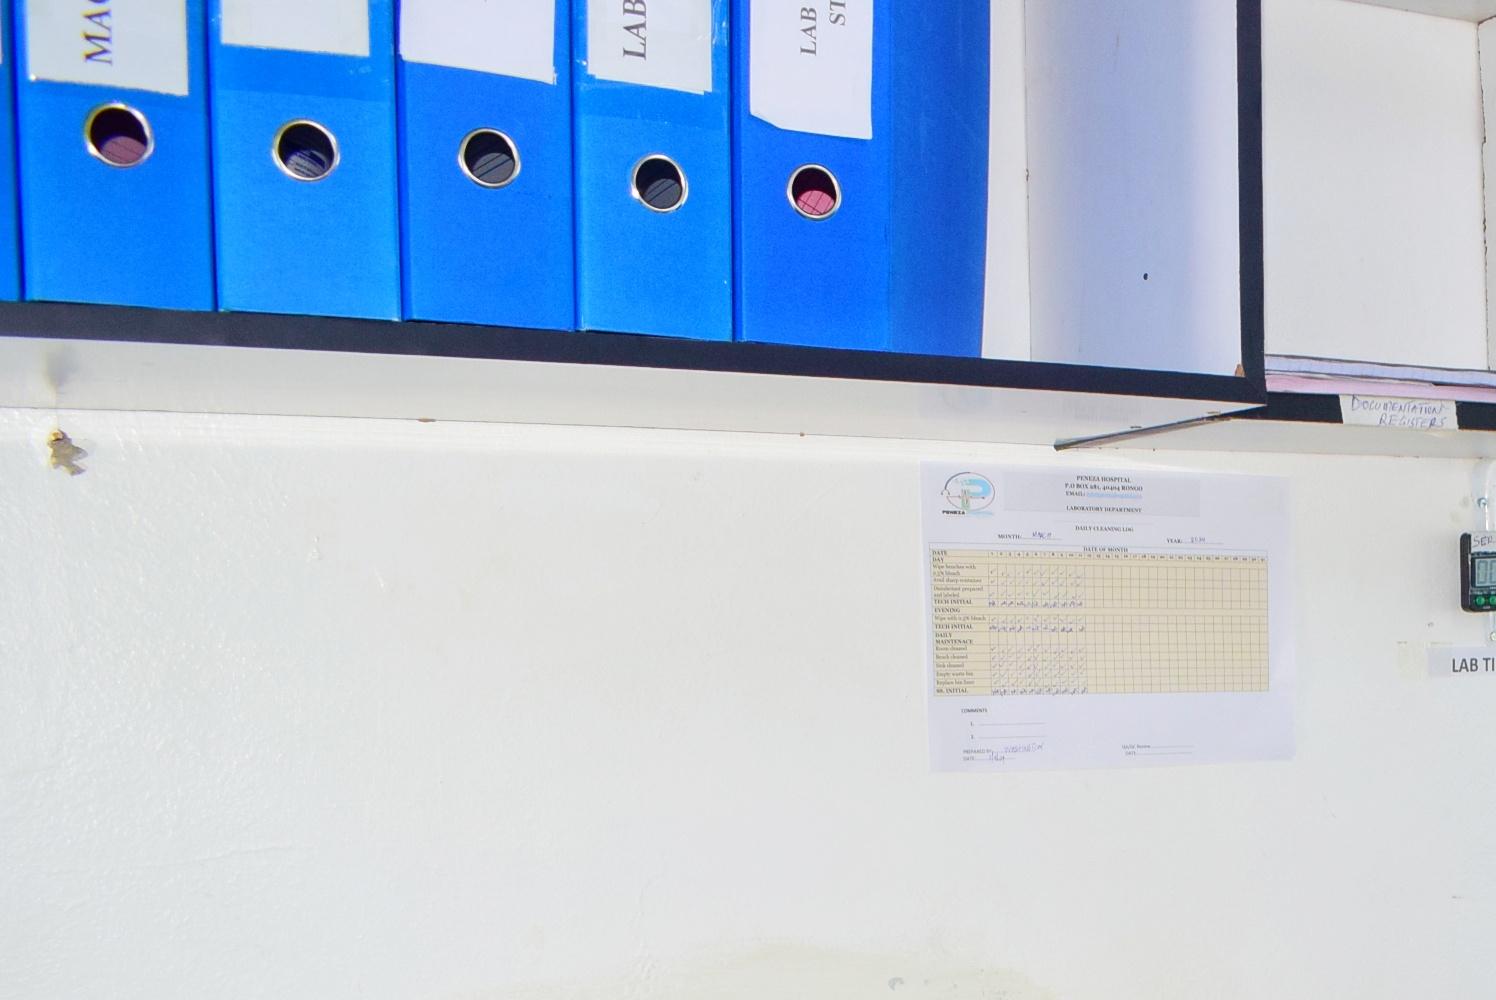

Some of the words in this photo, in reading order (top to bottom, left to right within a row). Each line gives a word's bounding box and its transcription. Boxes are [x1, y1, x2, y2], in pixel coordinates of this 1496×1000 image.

[83, 0, 112, 66] MA
[800, 7, 817, 56] LAB
[1452, 657, 1479, 673] LAB
